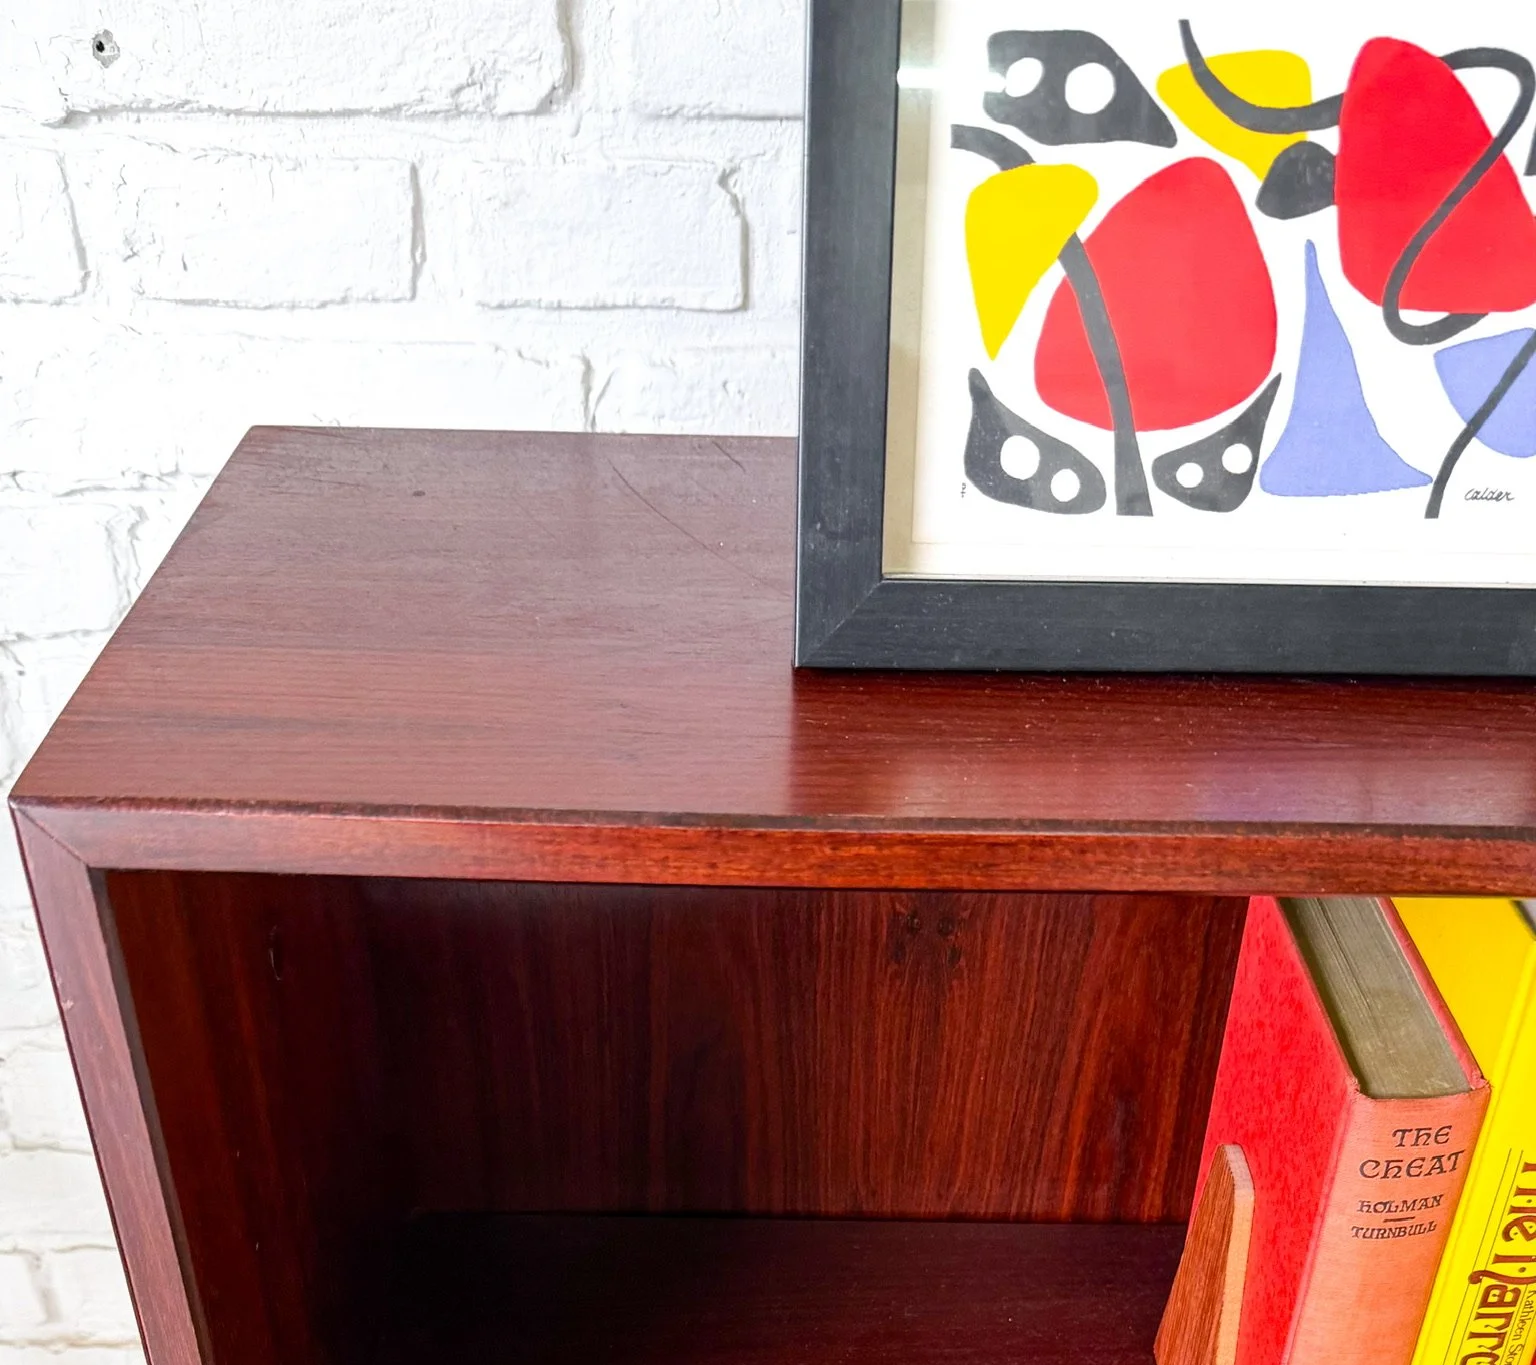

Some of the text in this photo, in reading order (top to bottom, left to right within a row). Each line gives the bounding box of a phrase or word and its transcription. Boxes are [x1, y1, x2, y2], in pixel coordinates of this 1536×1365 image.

[1392, 1125, 1452, 1147] THE
[1359, 1149, 1466, 1179] CHEAT
[1357, 1194, 1444, 1213] HOLMAN
[1351, 1221, 1437, 1239] TURNBULL
